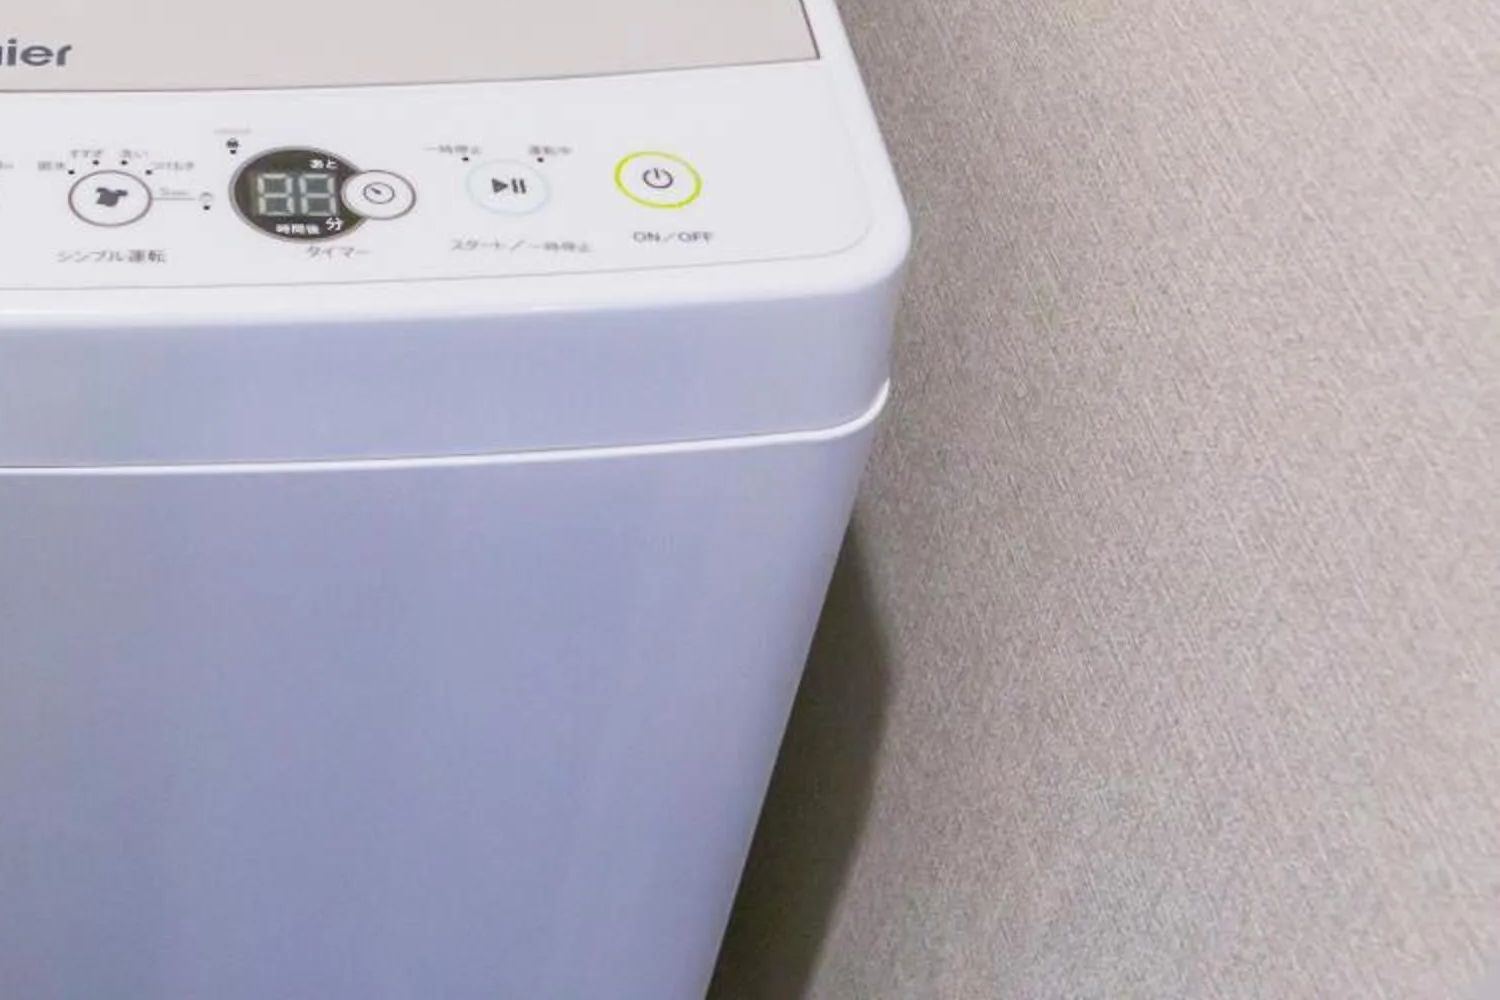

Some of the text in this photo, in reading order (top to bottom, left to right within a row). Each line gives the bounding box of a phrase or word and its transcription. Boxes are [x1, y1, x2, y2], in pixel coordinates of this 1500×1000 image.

[308, 158, 338, 169] あと
[325, 217, 343, 232] 分
[57, 249, 166, 264] シンプル運転
[306, 245, 372, 259] タイマー
